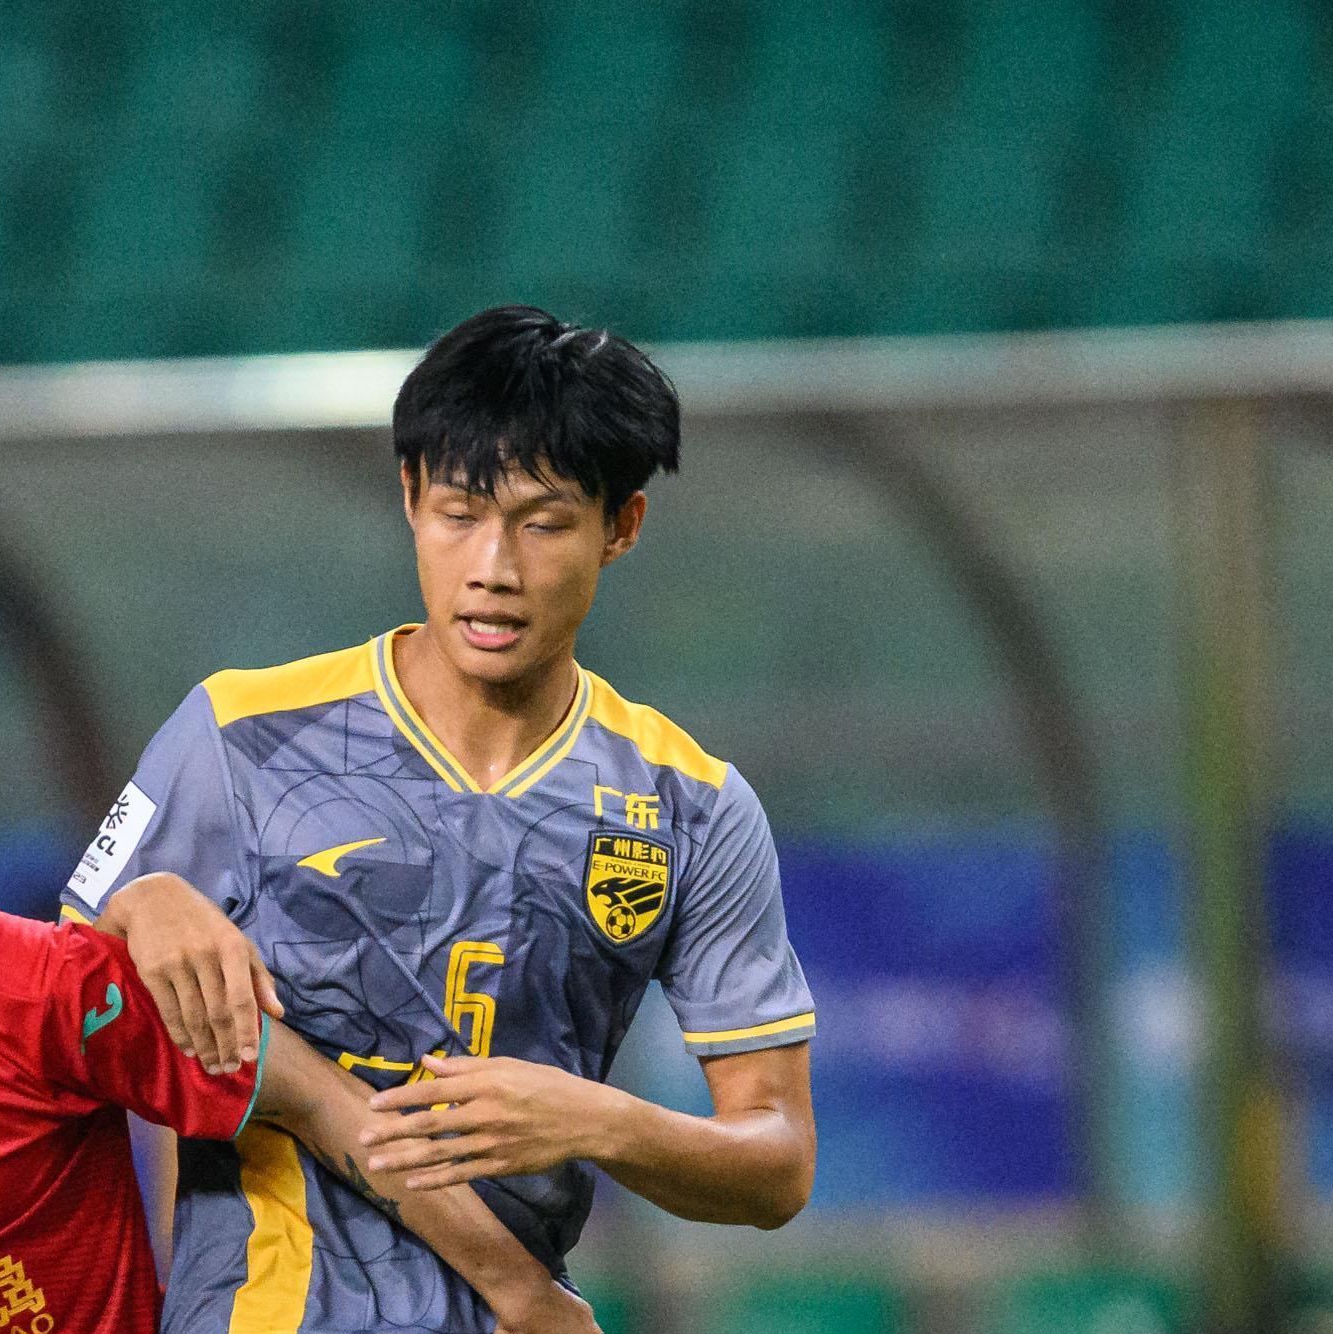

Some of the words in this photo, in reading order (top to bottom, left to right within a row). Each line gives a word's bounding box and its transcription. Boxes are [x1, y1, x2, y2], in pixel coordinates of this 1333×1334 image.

[593, 784, 660, 830] 广东
[594, 837, 668, 866] 广州影豹
[593, 860, 649, 879] E-POWER
[651, 870, 666, 881] FC
[444, 940, 505, 1058] 6
